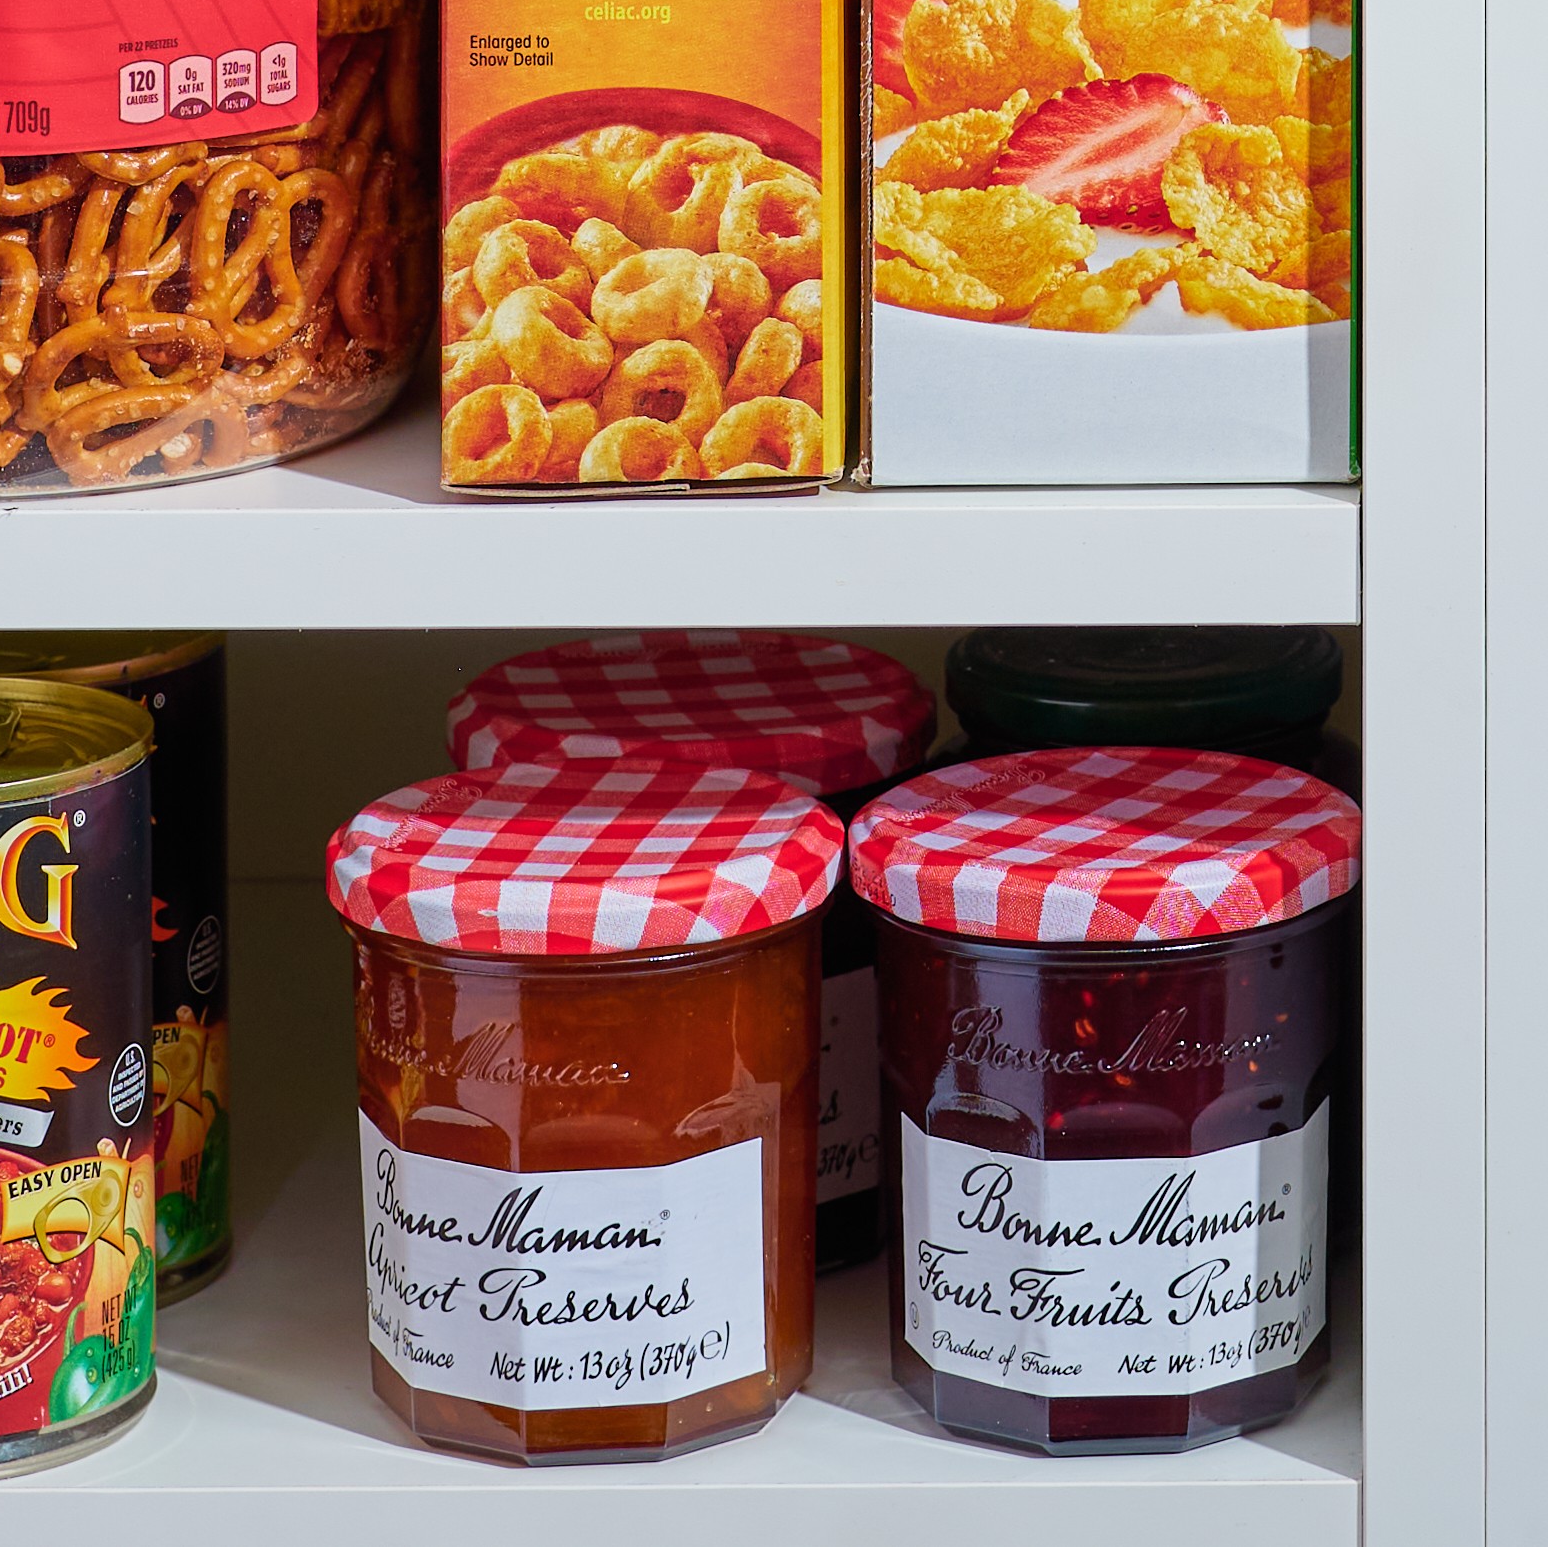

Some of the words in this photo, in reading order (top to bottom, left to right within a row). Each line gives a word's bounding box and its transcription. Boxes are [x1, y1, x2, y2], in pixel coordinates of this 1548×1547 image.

[584, 2, 671, 23] celiac.org
[469, 52, 508, 66] Show
[514, 51, 553, 66] Detail
[958, 1162, 1103, 1248] Bonne
[1109, 1172, 1283, 1248] Maman
[916, 1239, 1002, 1314] Four
[1010, 1267, 1152, 1329] Fruits
[1166, 1239, 1315, 1328] Preserves
